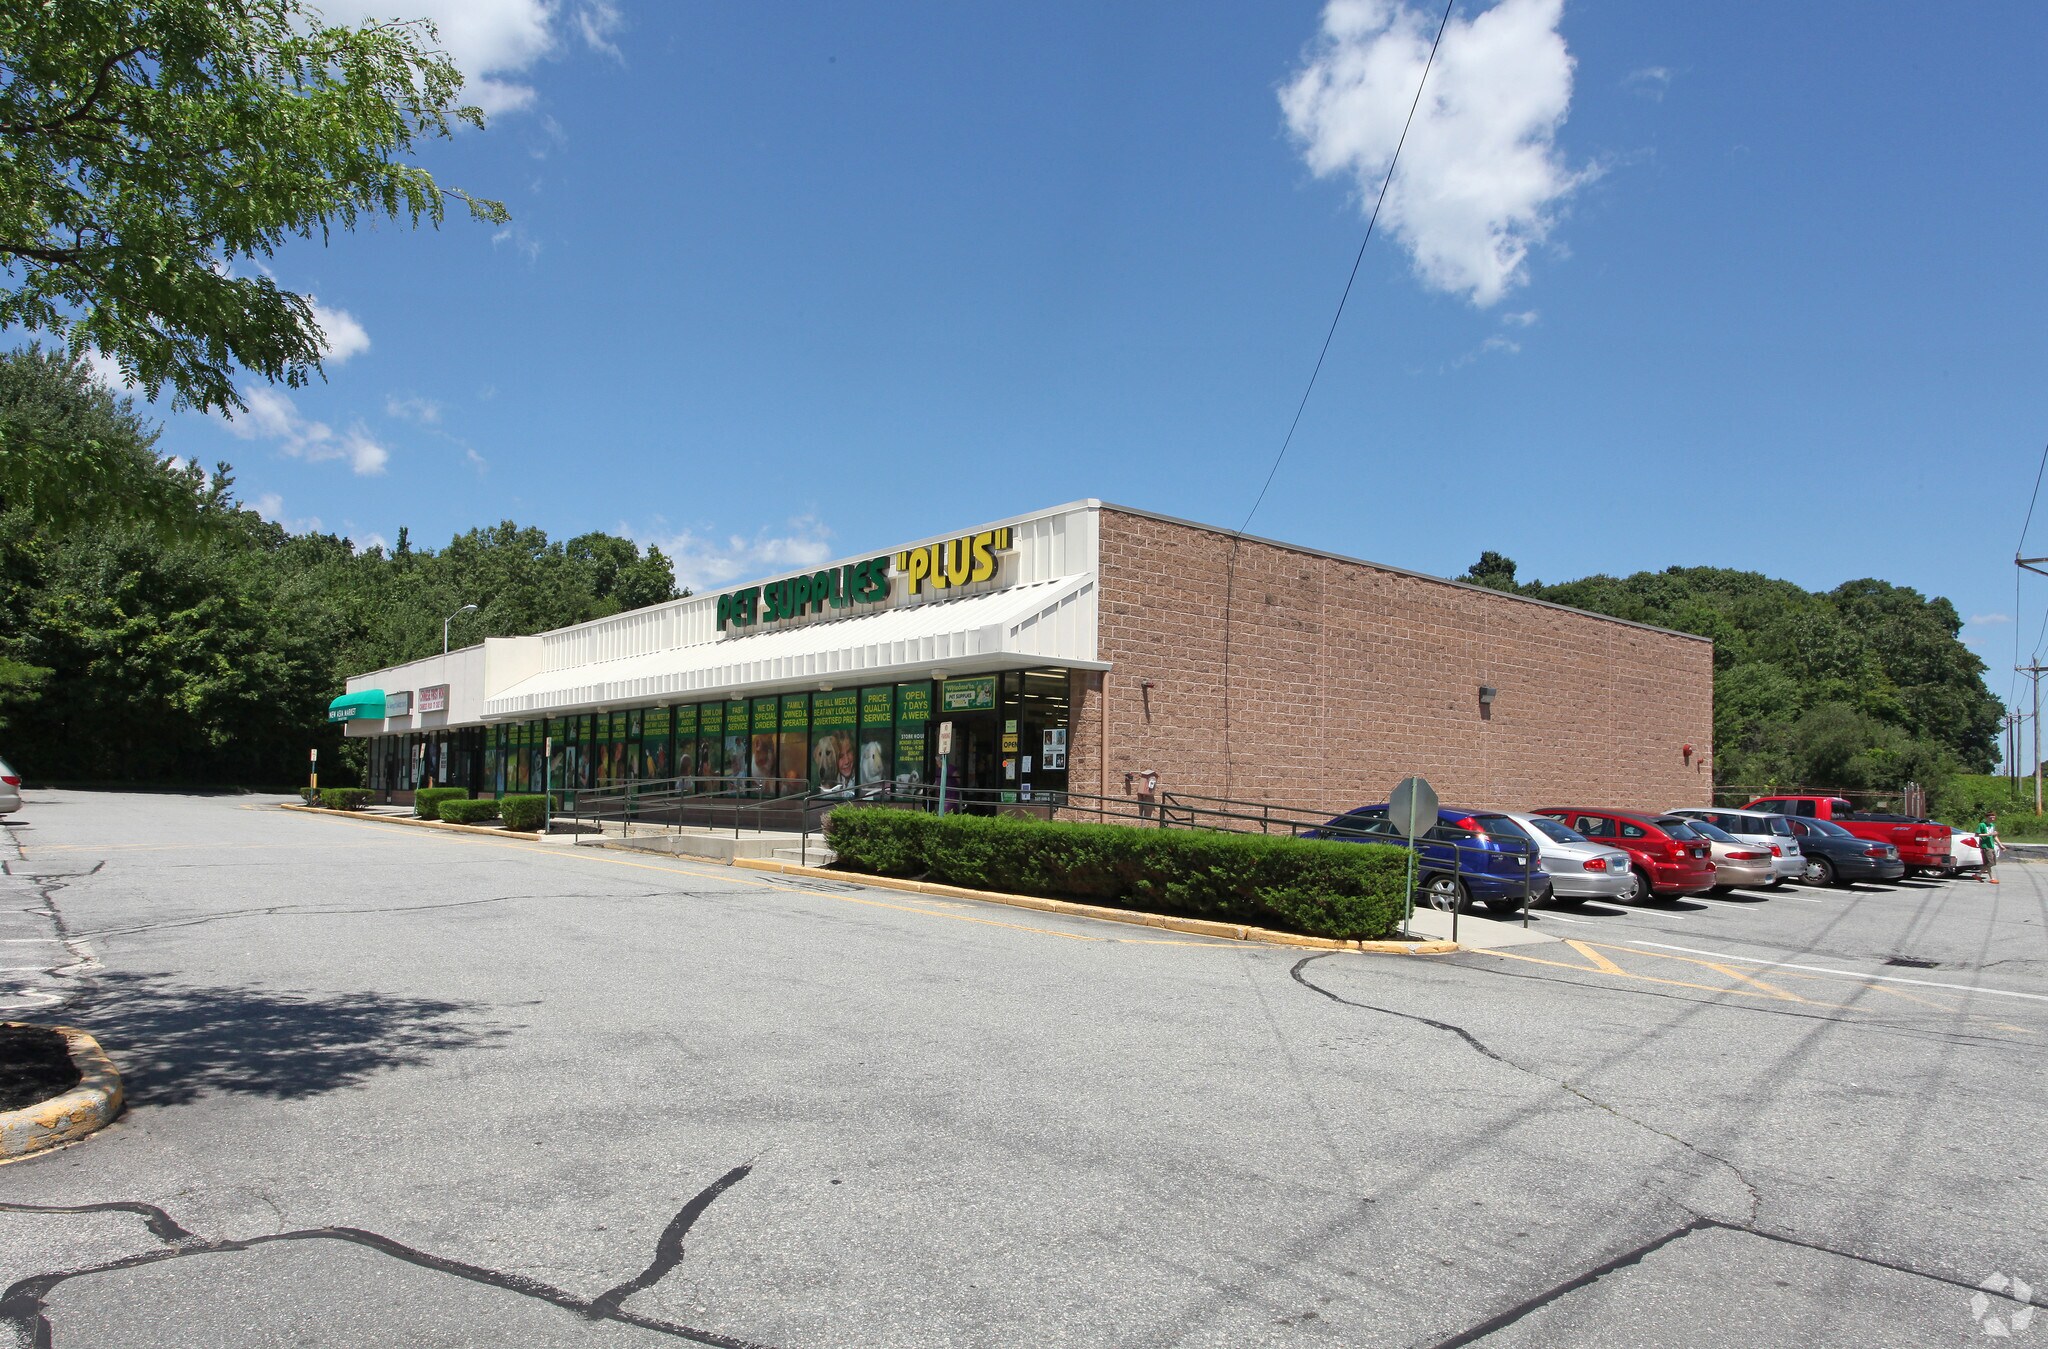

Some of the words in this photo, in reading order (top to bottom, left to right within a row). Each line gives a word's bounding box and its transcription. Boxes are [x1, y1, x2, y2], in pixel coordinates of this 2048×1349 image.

[716, 586, 761, 632] PET
[763, 557, 891, 623] SUPPLIES
[896, 528, 1013, 595] "PLUS"
[868, 694, 886, 702] PRICE
[905, 691, 926, 700] OPEN
[787, 701, 804, 709] FAMILY
[864, 704, 891, 712] QUALITY
[904, 702, 907, 710] 7
[909, 701, 928, 709] DAYS
[344, 708, 356, 716] MARKET
[755, 712, 776, 720] SPECIAL
[909, 711, 929, 720] WEEK
[814, 717, 842, 725] ADVERTISED
[864, 713, 890, 722] SERVICE
